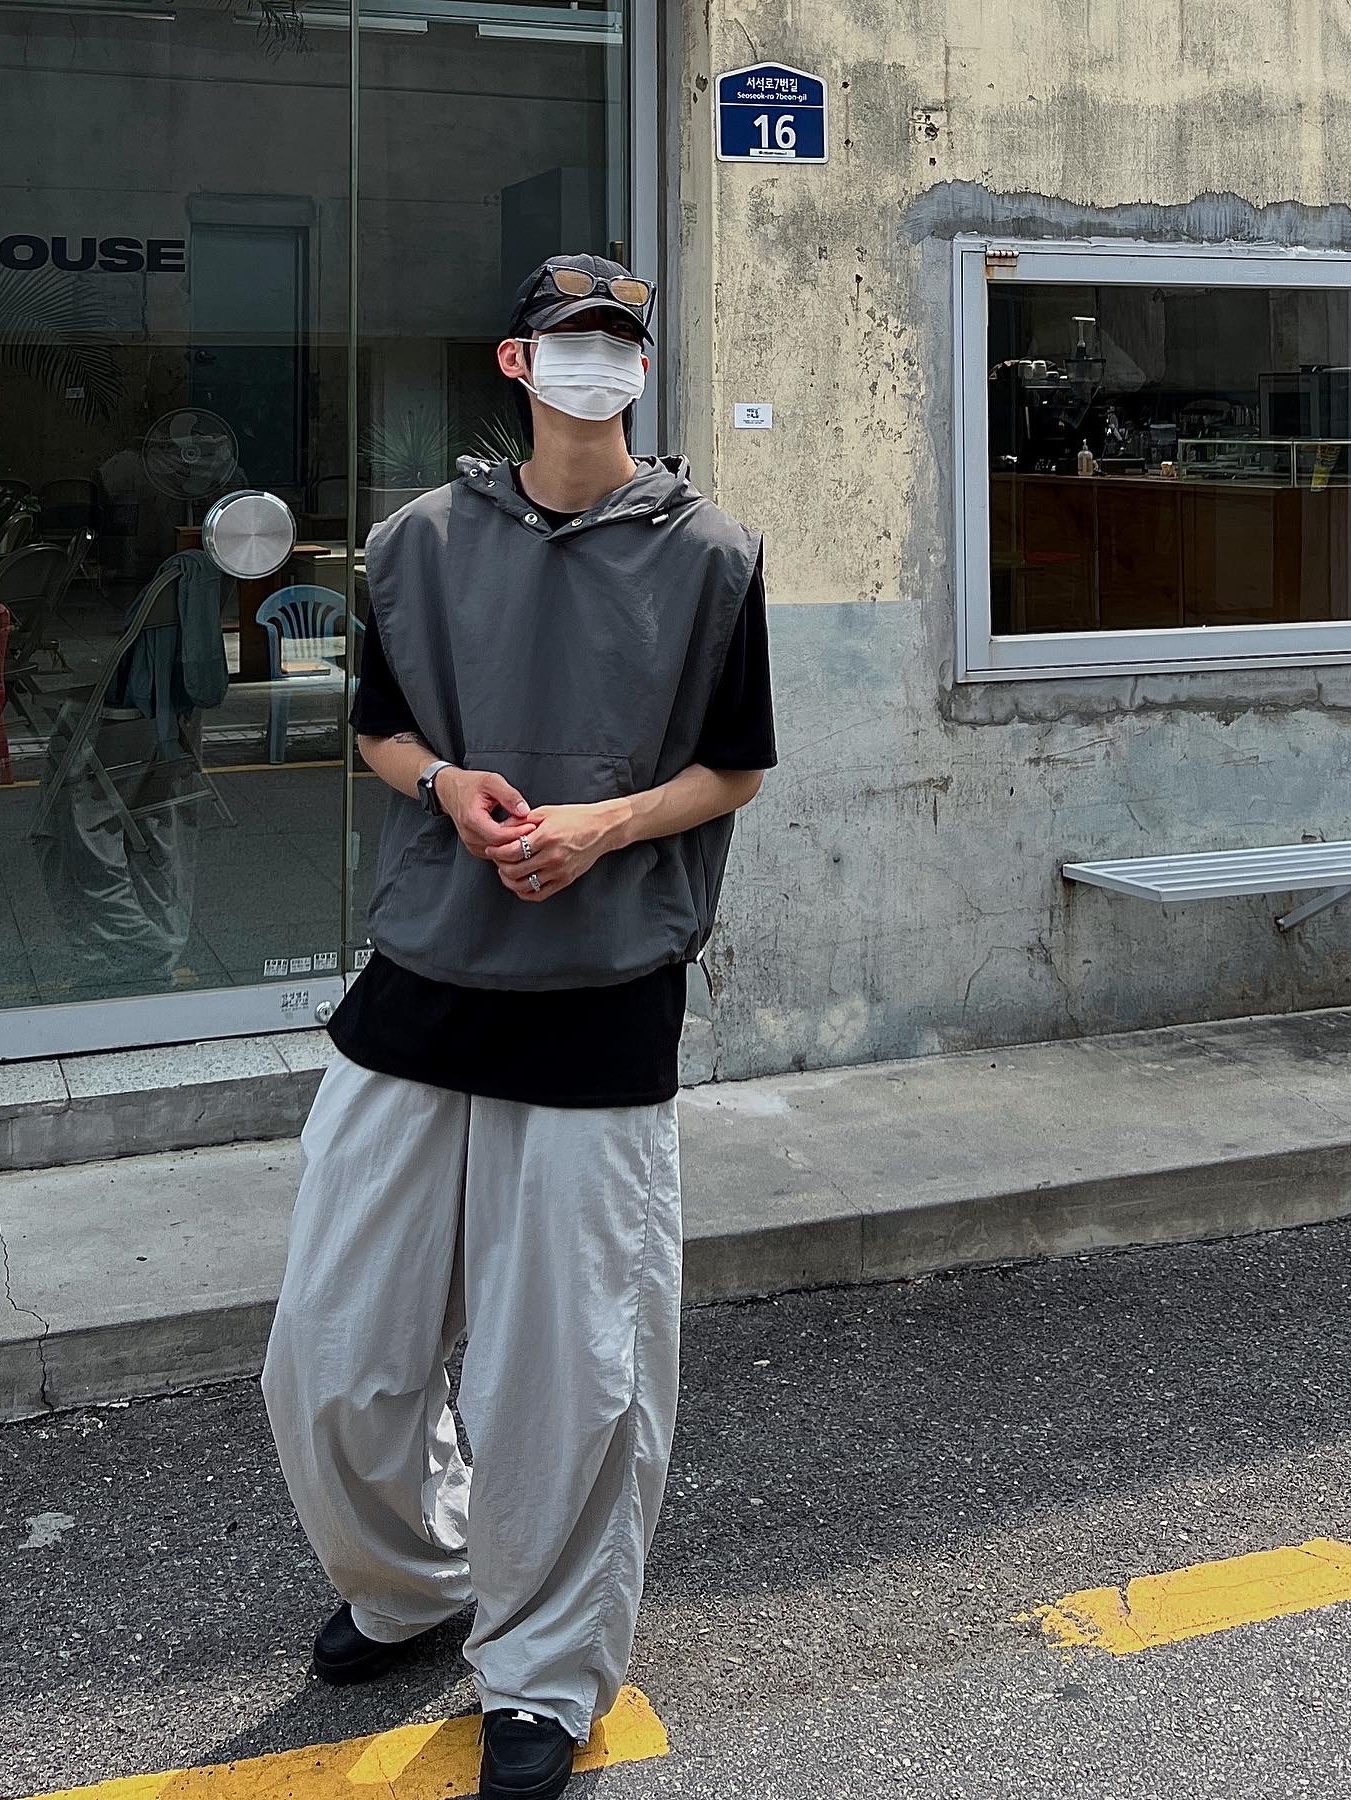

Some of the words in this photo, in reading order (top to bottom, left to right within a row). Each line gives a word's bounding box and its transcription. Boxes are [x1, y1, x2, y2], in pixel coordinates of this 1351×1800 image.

[737, 91, 775, 100] Seoseok-ro
[775, 93, 807, 102] 7beon-gil
[746, 76, 798, 93] 서석로7번길
[753, 114, 797, 149] 16
[0, 234, 186, 273] OUSE
